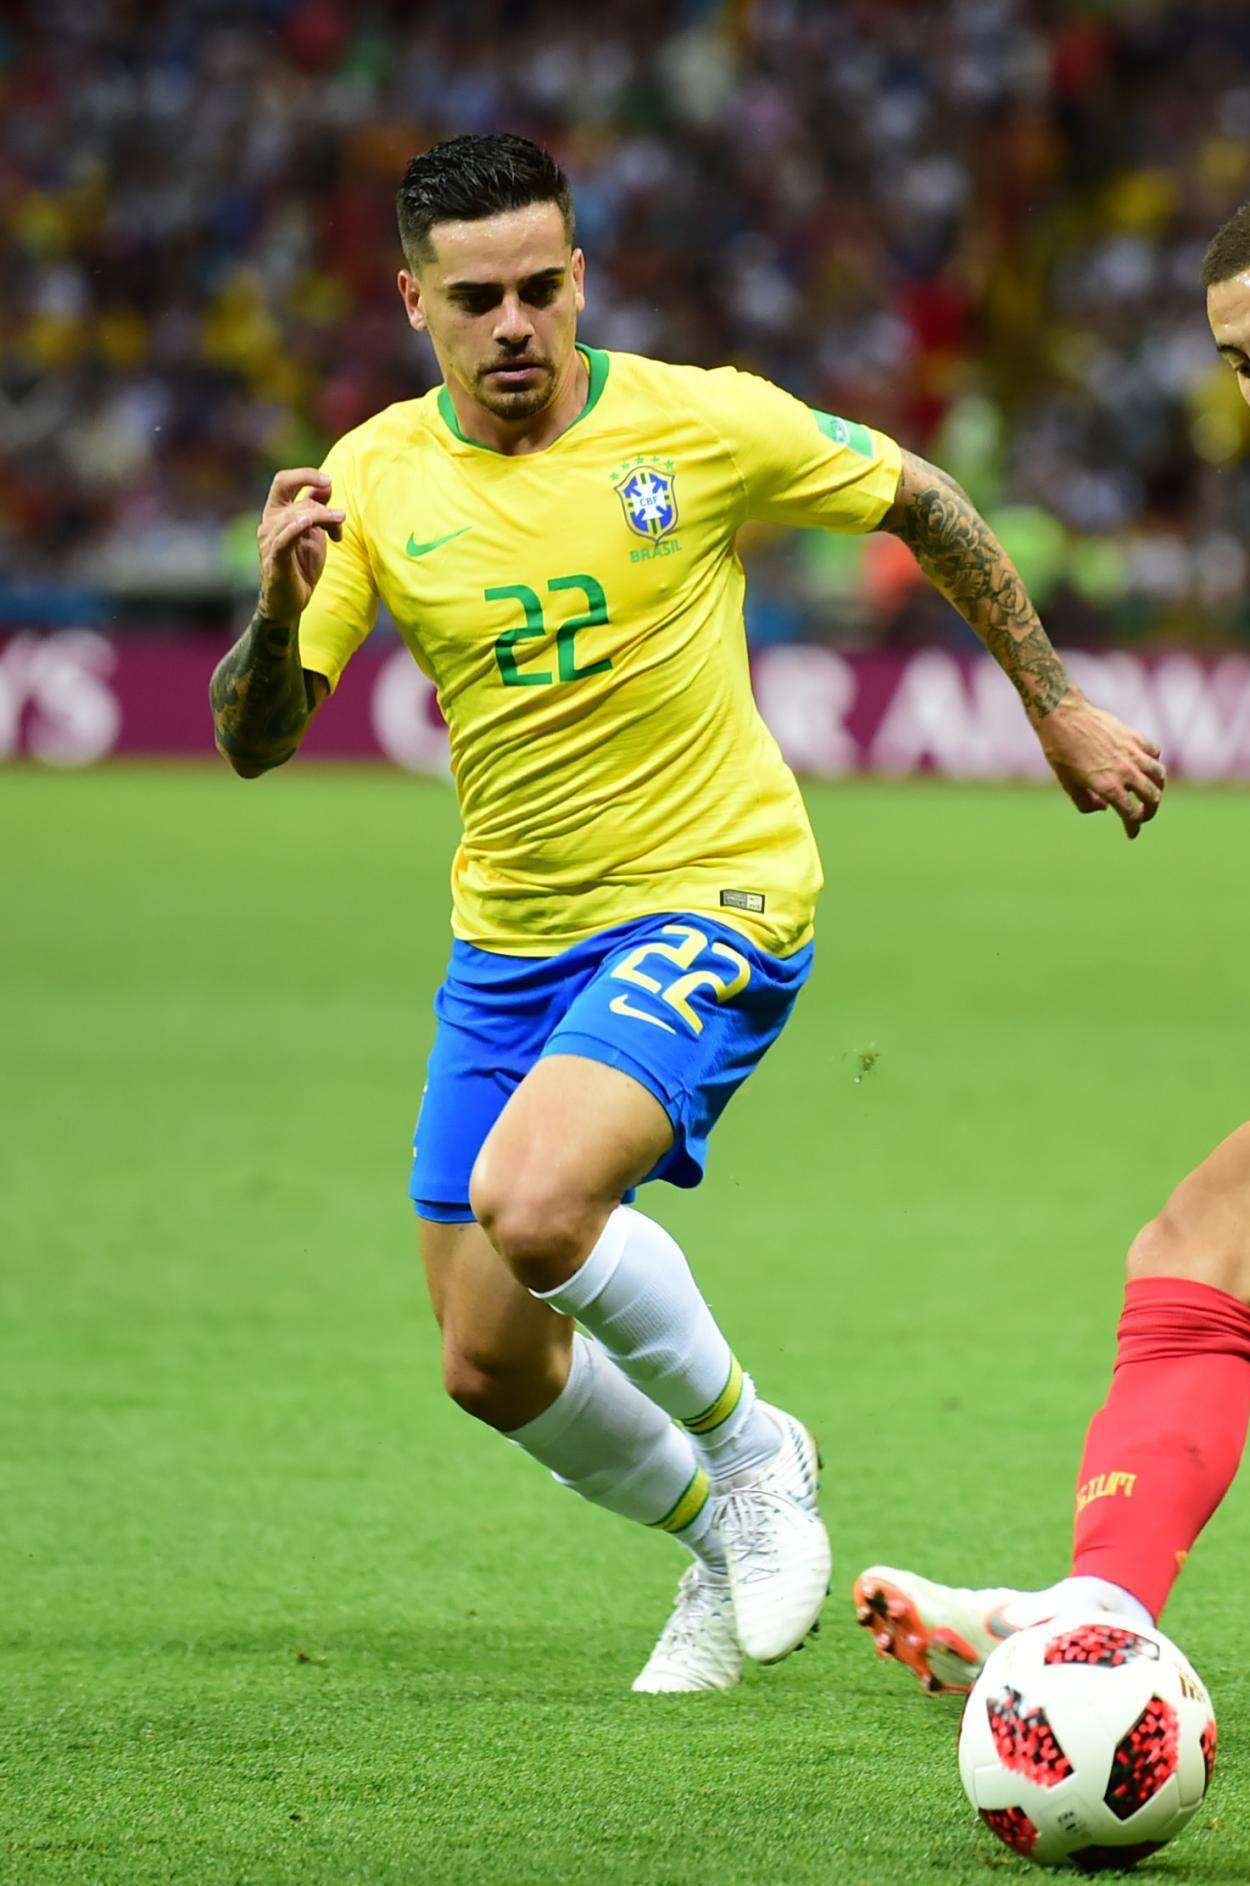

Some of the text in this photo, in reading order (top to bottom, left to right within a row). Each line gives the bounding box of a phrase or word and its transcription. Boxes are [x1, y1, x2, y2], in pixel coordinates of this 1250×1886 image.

[640, 496, 657, 506] CBF
[630, 540, 682, 563] BRASIL
[485, 574, 613, 686] 22
[611, 925, 751, 1035] 22
